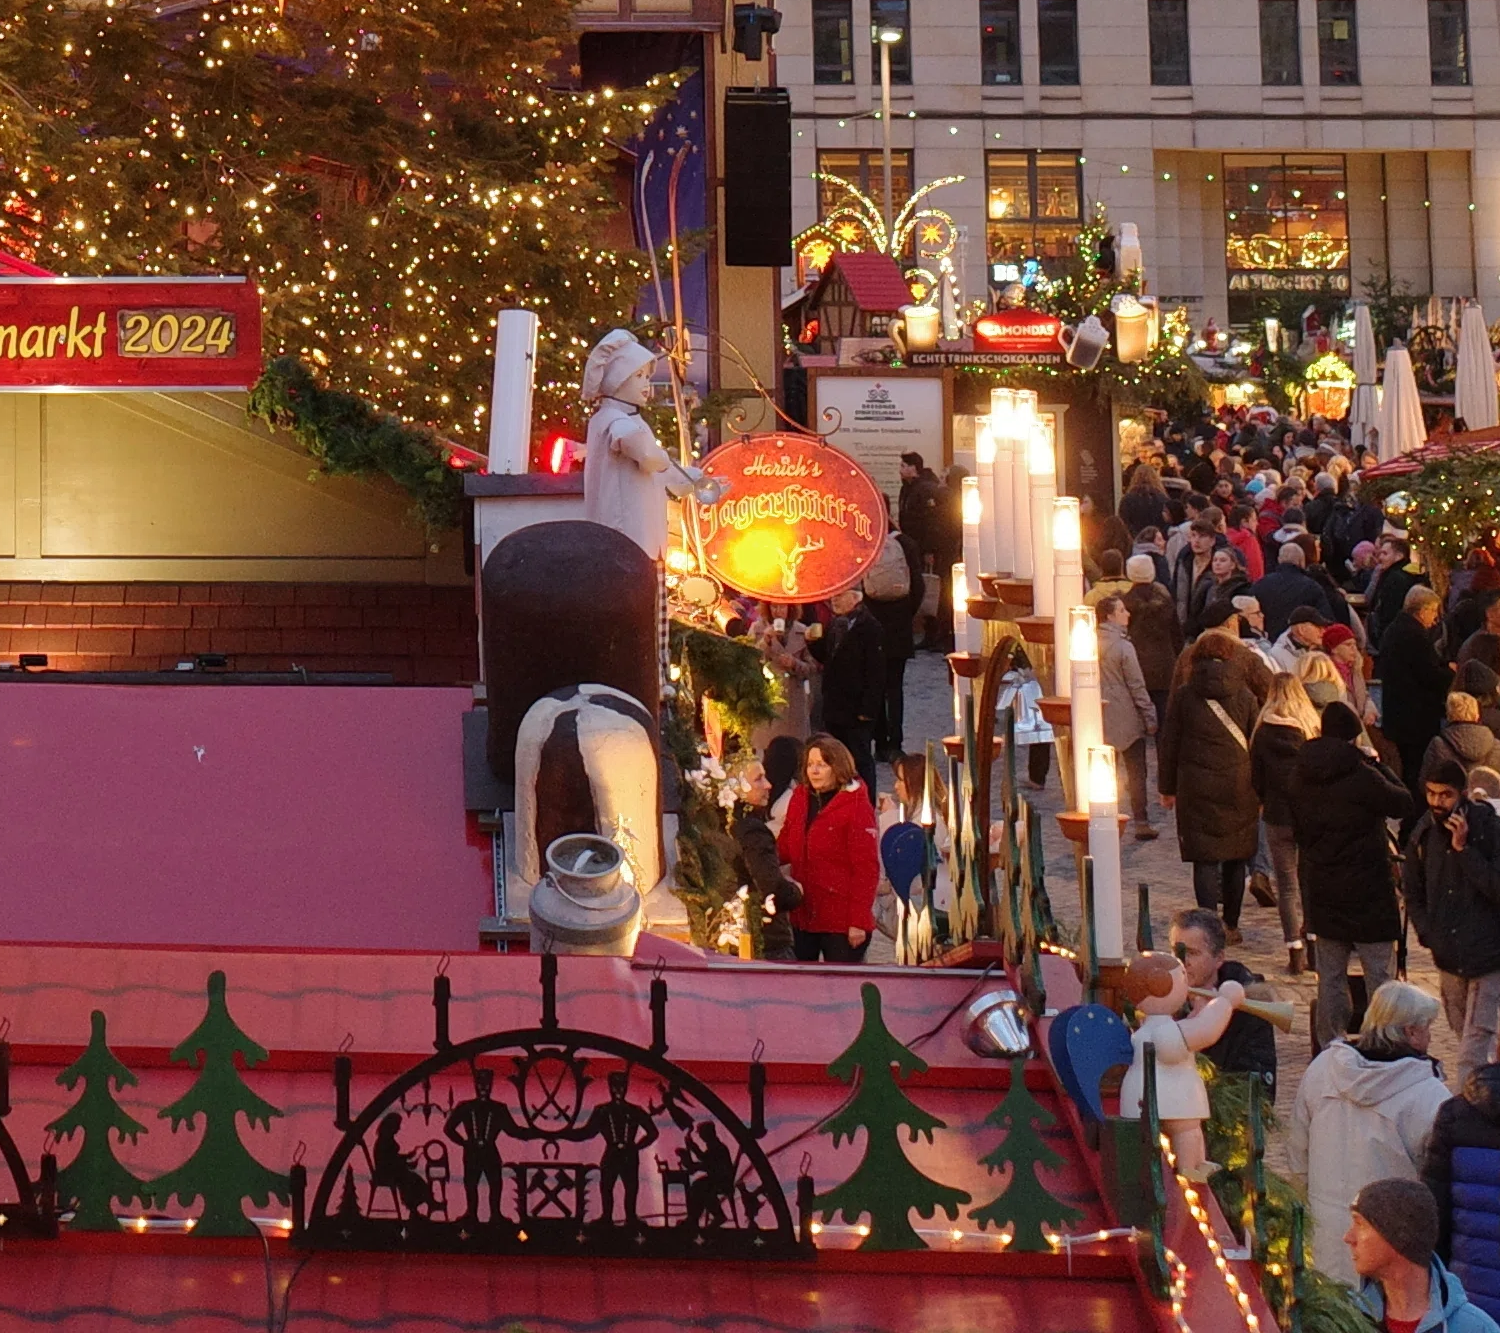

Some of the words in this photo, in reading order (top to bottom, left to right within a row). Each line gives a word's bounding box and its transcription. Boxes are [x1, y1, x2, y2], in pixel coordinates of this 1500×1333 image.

[123, 313, 232, 354] 2024
[984, 324, 1055, 336] AMONDAS
[912, 354, 946, 364] ECHTE
[949, 353, 1061, 364] TRINKSCHOKOLADEN
